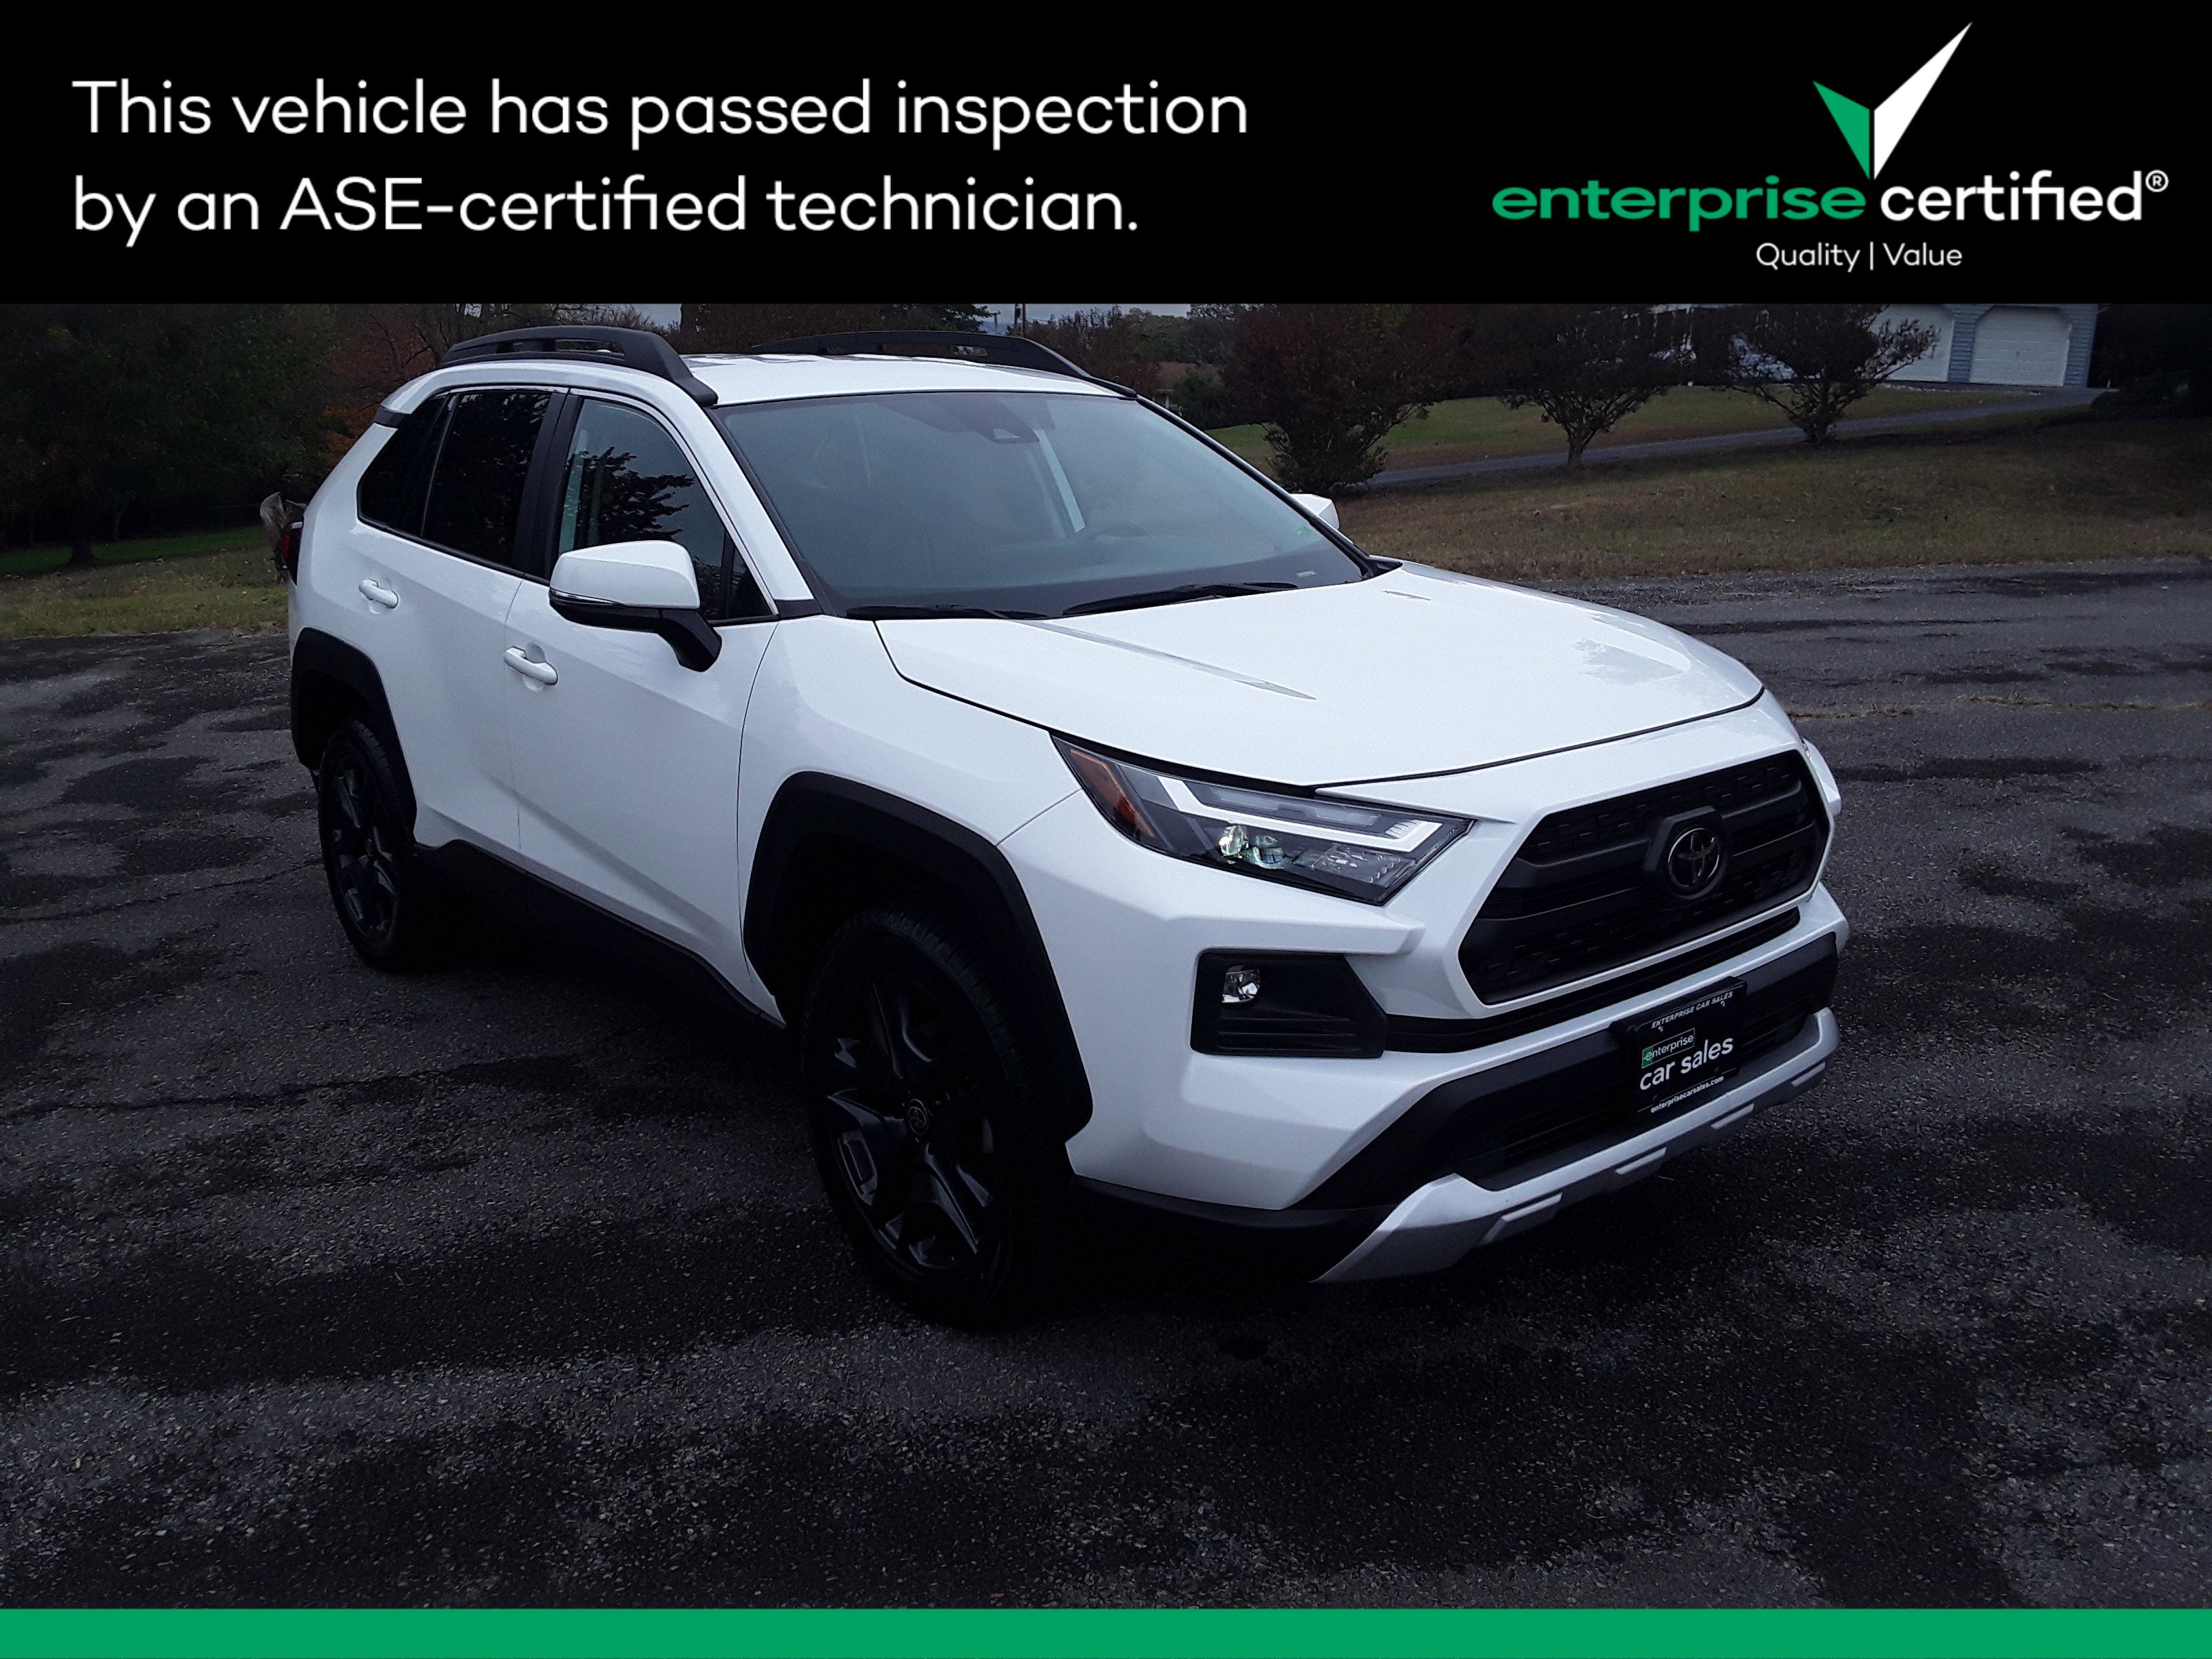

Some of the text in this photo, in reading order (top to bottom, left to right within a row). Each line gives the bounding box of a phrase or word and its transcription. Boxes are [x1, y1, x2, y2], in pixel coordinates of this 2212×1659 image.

[1651, 991, 1733, 1029] ENTERPRISE CAR SALES
[1640, 1038, 1734, 1090] car sales
[1643, 1035, 1694, 1061] enterprise
[1650, 1076, 1724, 1113] enterprisecarsales.com
